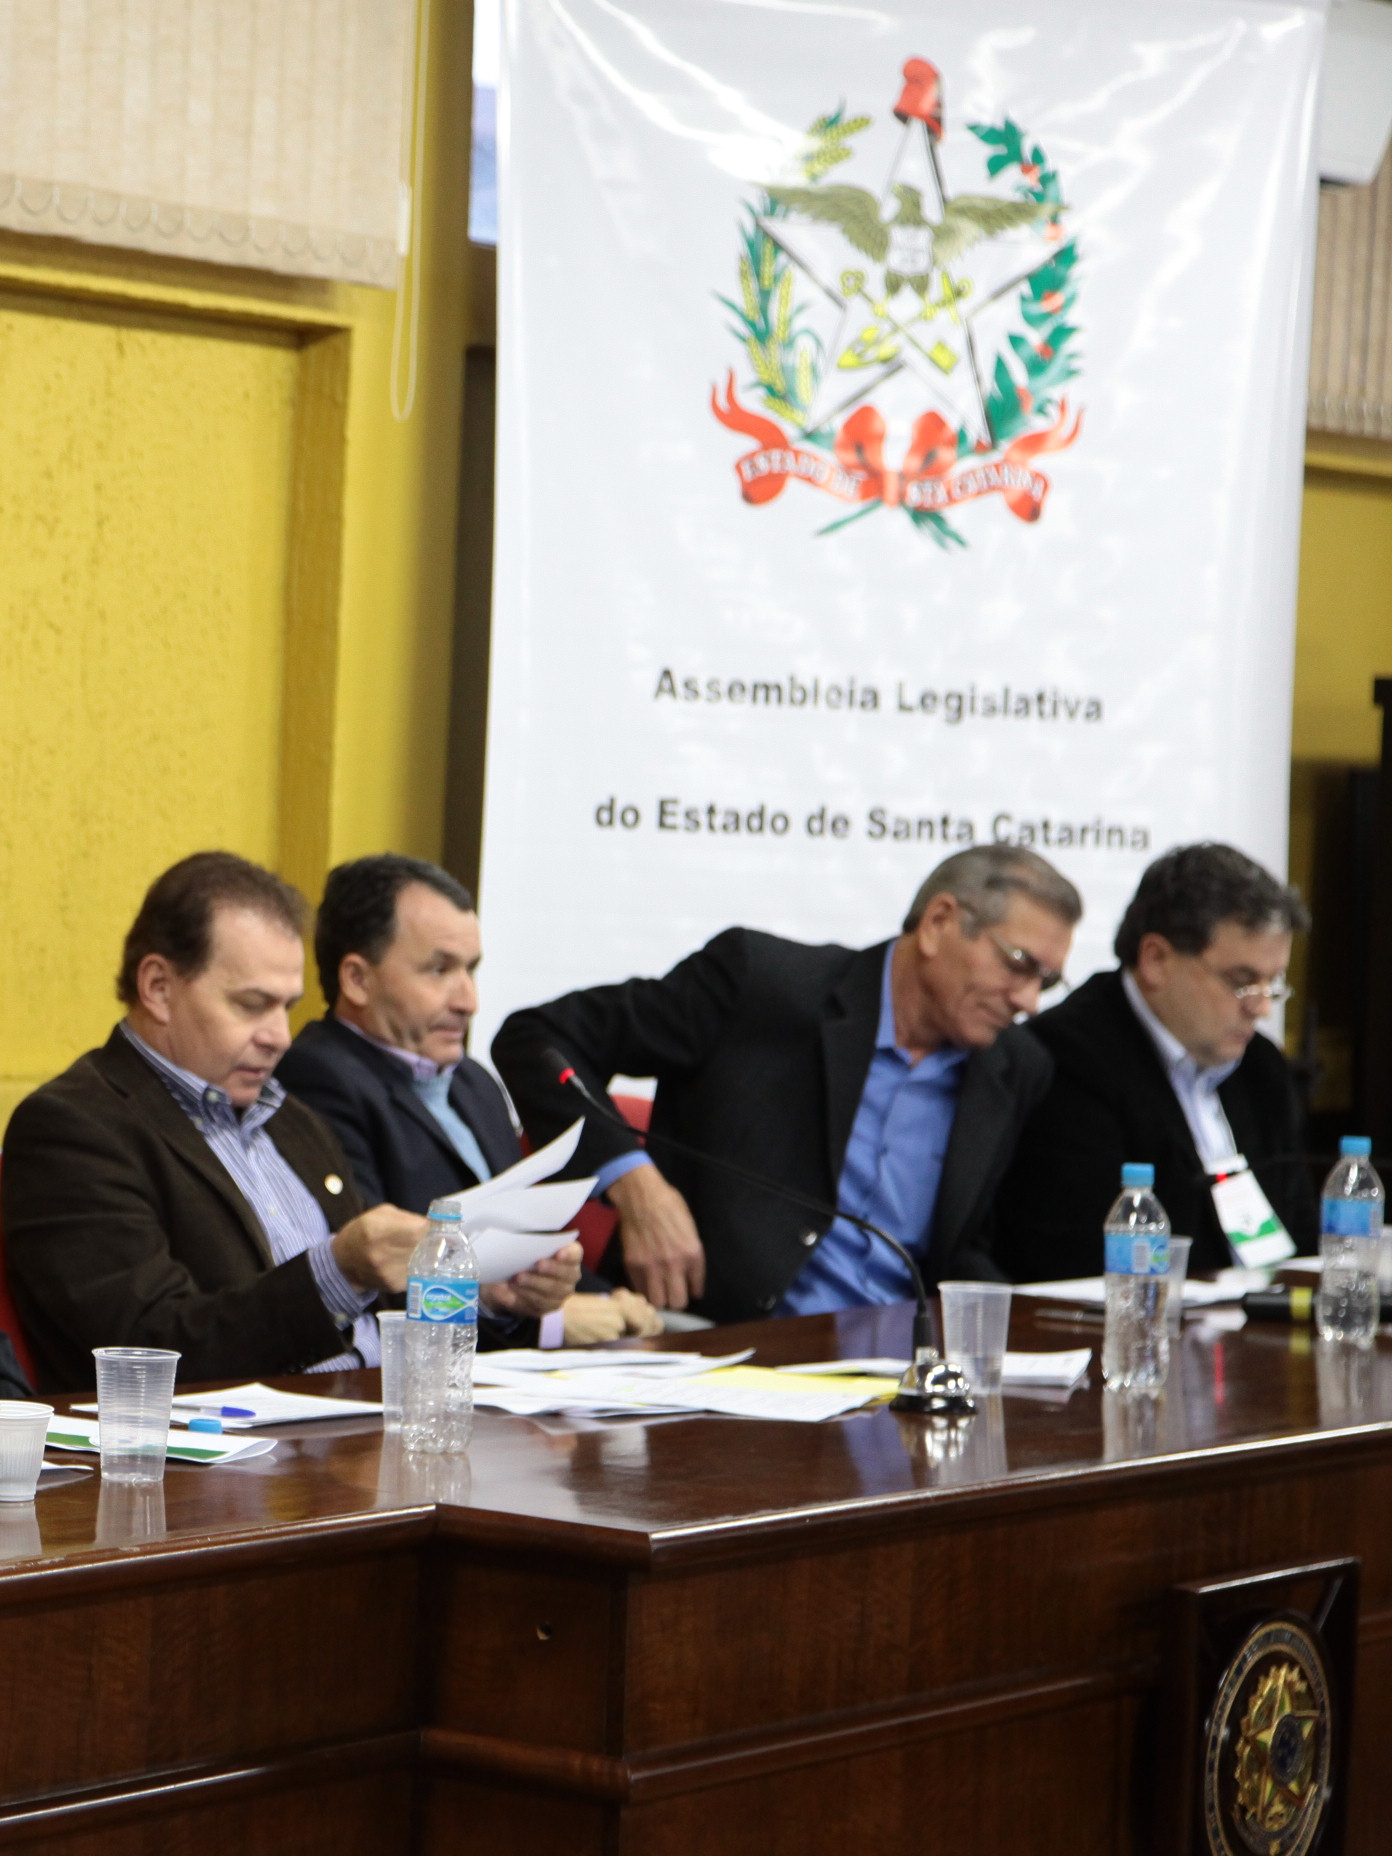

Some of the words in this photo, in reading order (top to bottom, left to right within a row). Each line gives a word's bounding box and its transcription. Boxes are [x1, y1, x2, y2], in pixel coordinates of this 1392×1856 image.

[654, 667, 880, 711] Assembleia
[897, 681, 1103, 725] Legislativa
[594, 795, 641, 830] do
[656, 797, 791, 836] Estado
[805, 804, 851, 839] de
[866, 806, 976, 844] Santa
[992, 812, 1150, 850] Catarina
